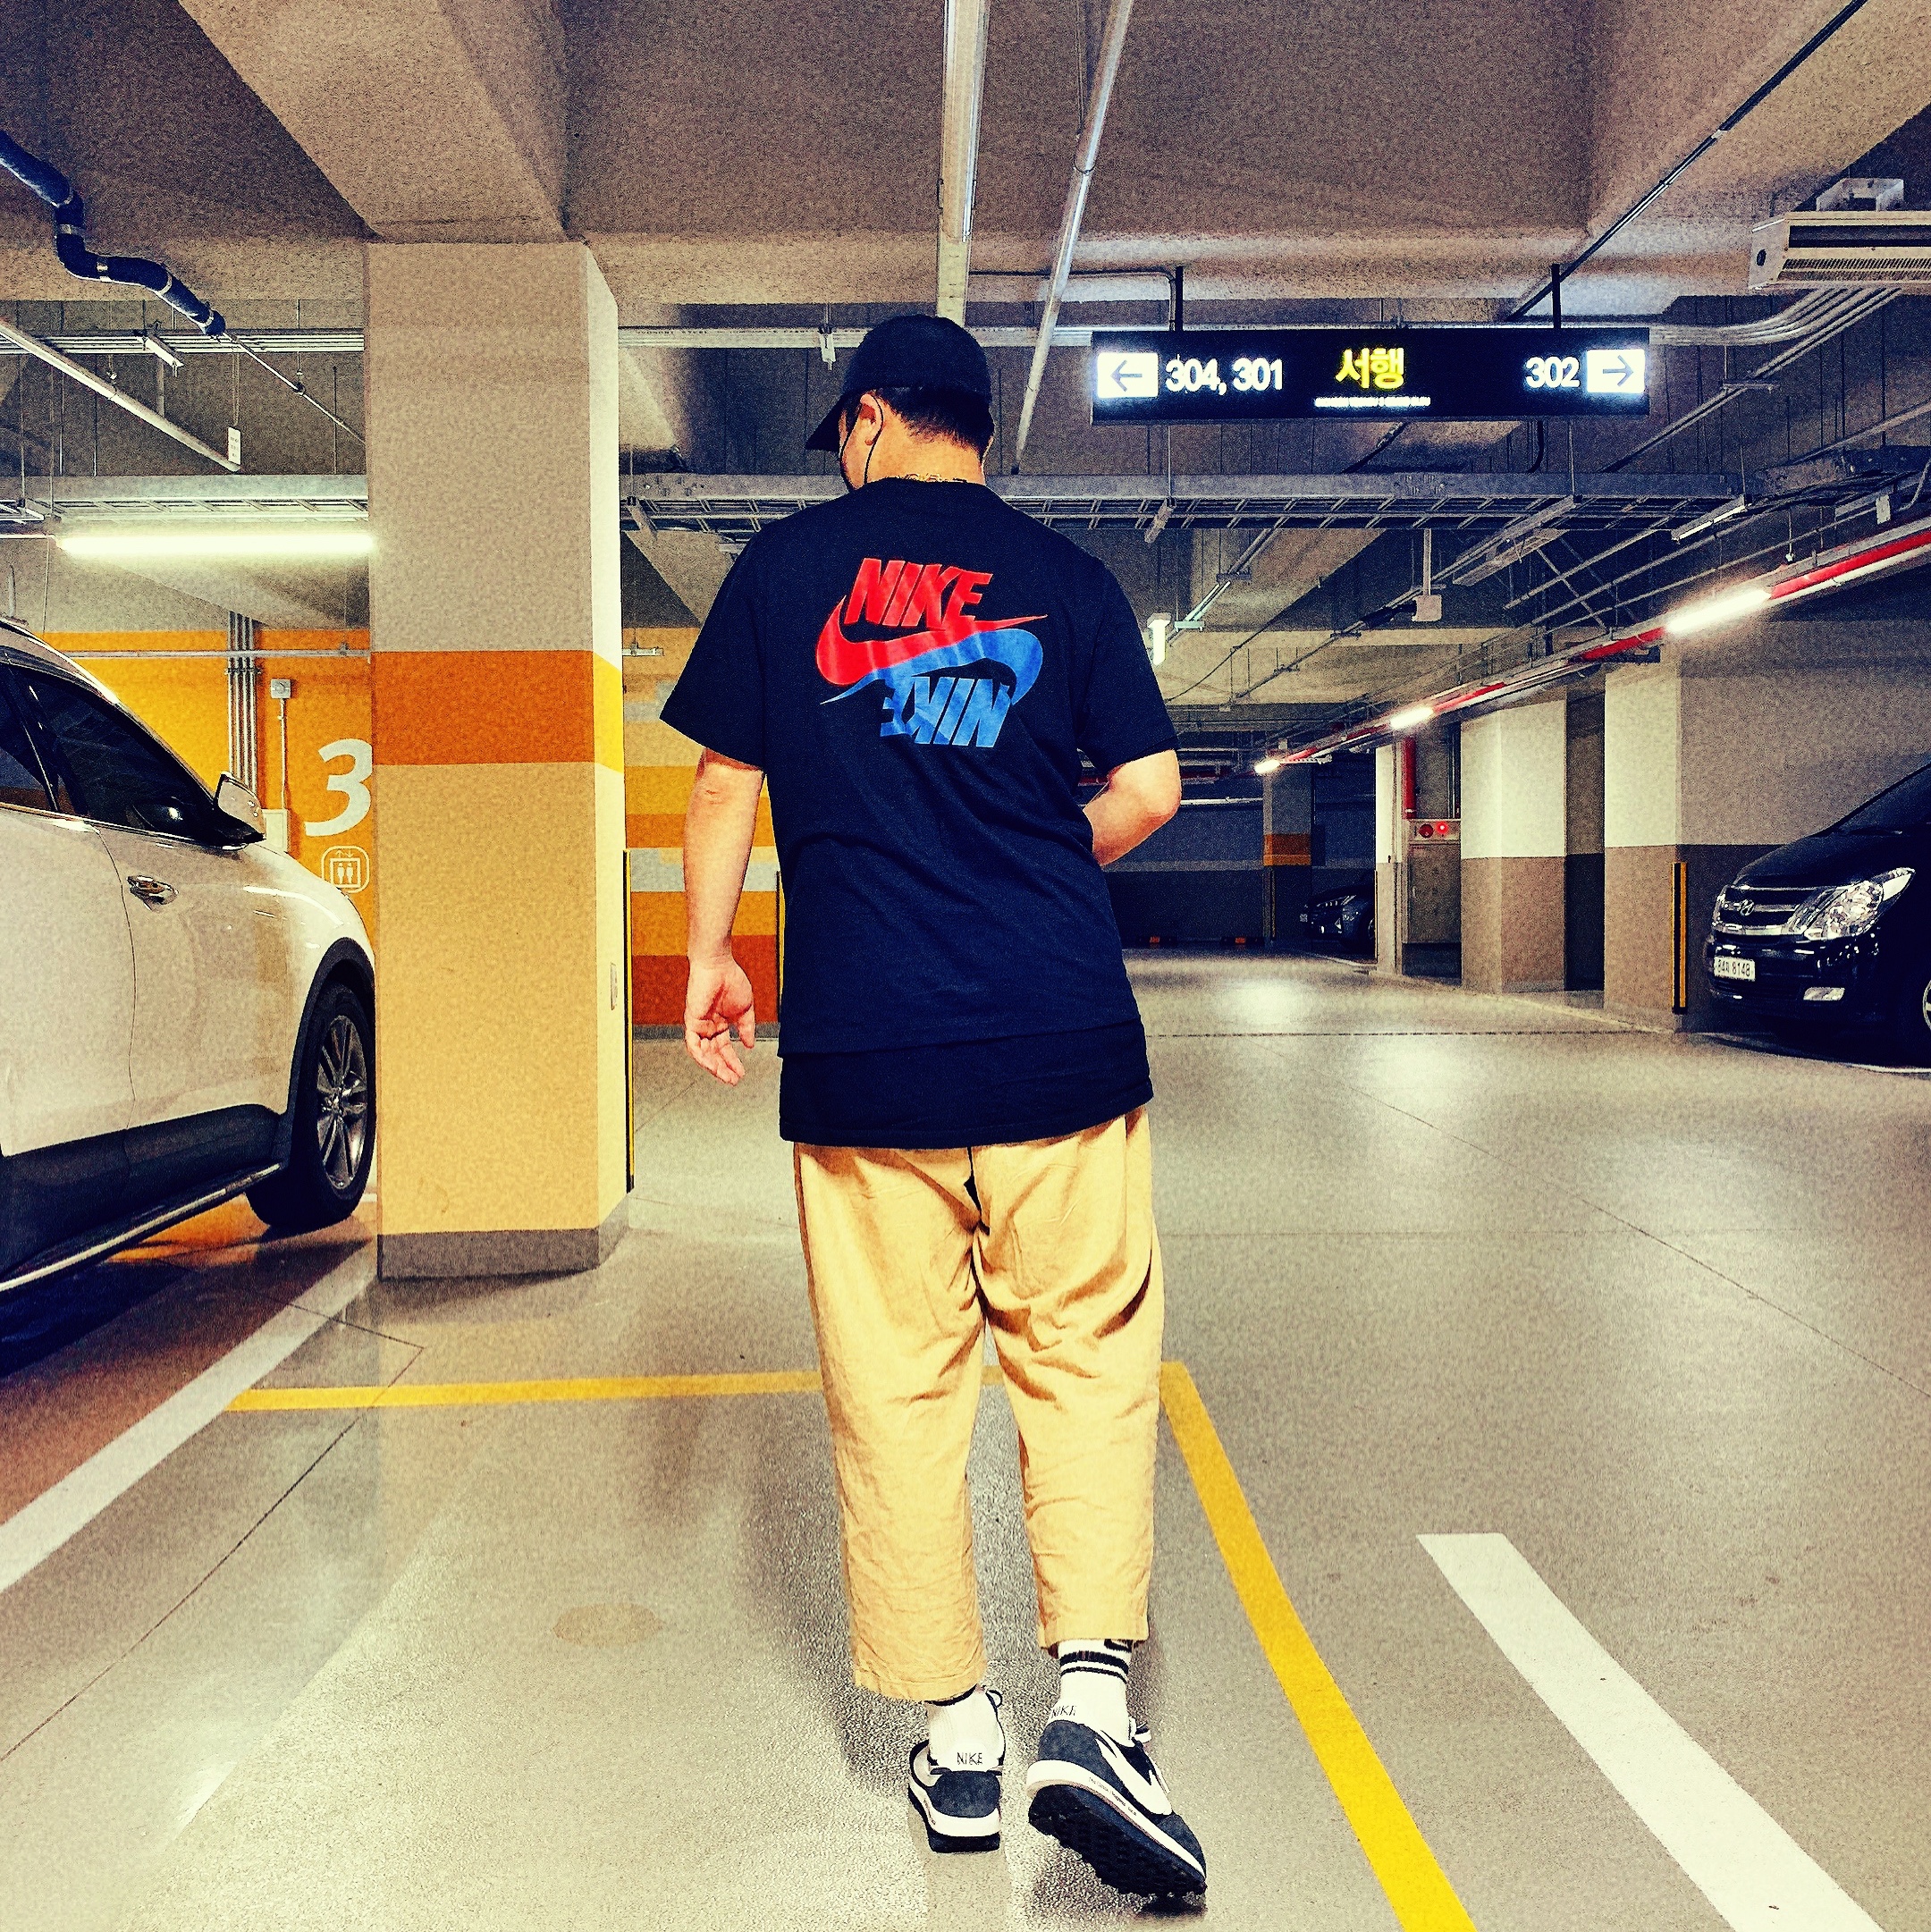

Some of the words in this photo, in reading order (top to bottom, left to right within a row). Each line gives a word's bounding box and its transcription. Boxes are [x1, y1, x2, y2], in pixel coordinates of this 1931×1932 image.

[1165, 357, 1227, 395] 304,
[1233, 357, 1283, 392] 301
[1336, 347, 1404, 390] 서행
[1525, 356, 1581, 388] 302
[843, 557, 994, 629] NIKE
[304, 738, 373, 838] 3
[957, 1751, 983, 1766] NIKE
